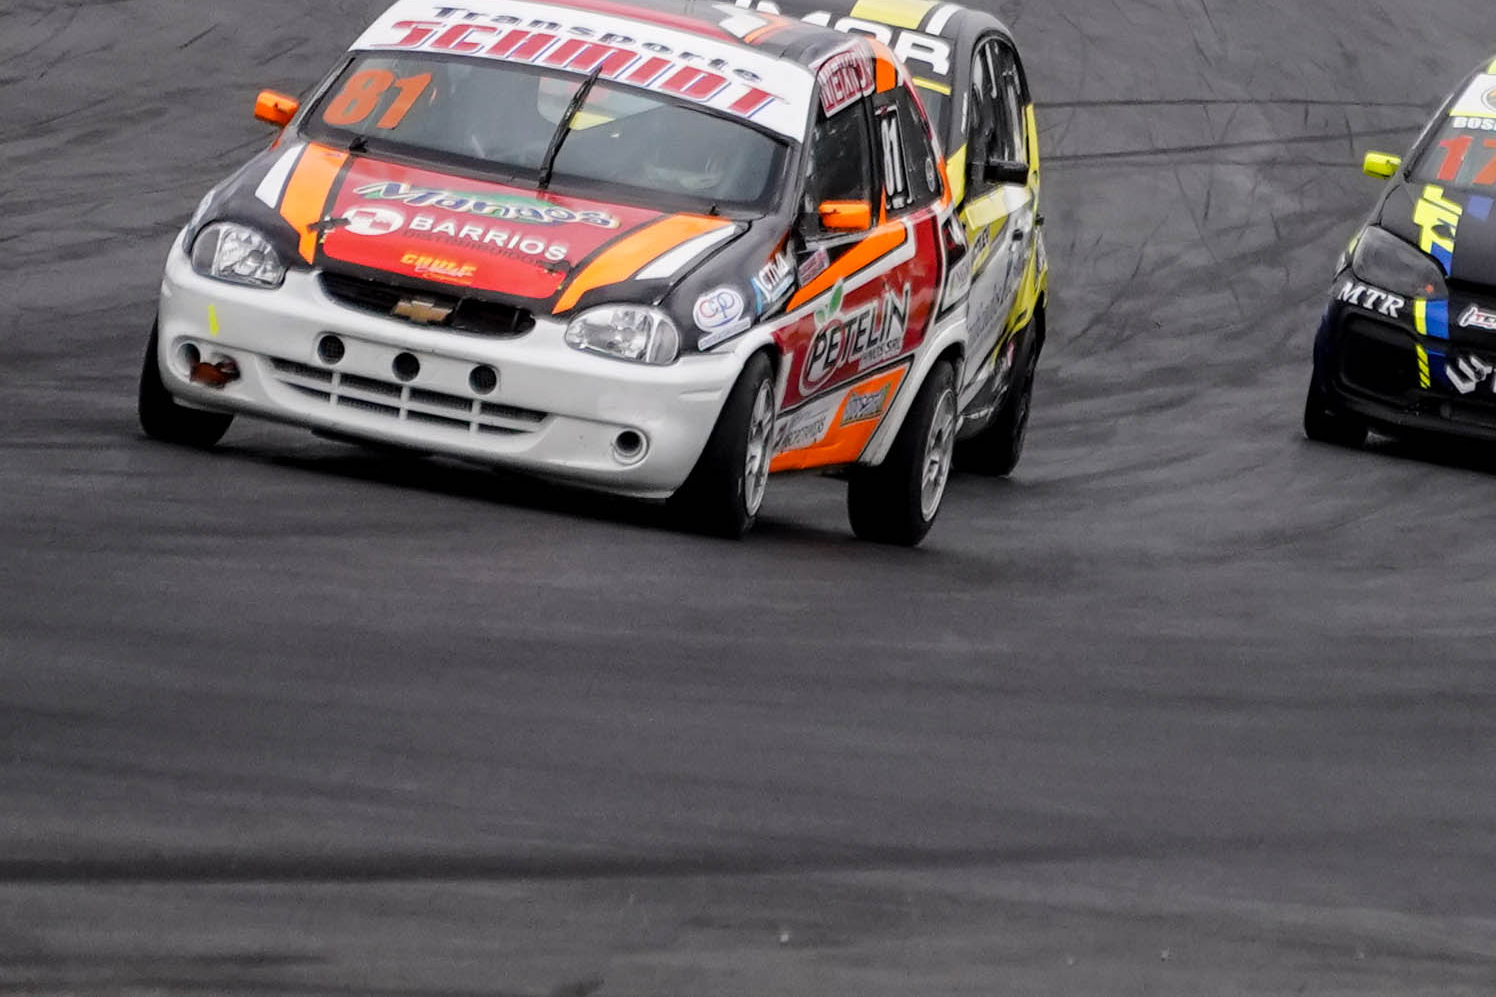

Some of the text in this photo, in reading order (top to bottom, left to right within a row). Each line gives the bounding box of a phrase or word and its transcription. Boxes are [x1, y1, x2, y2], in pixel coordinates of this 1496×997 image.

[432, 6, 765, 83] Transporte
[321, 69, 435, 130] 81
[408, 216, 569, 262] BARRIOS
[1336, 281, 1405, 319] MTR
[806, 283, 911, 380] PETELIN
